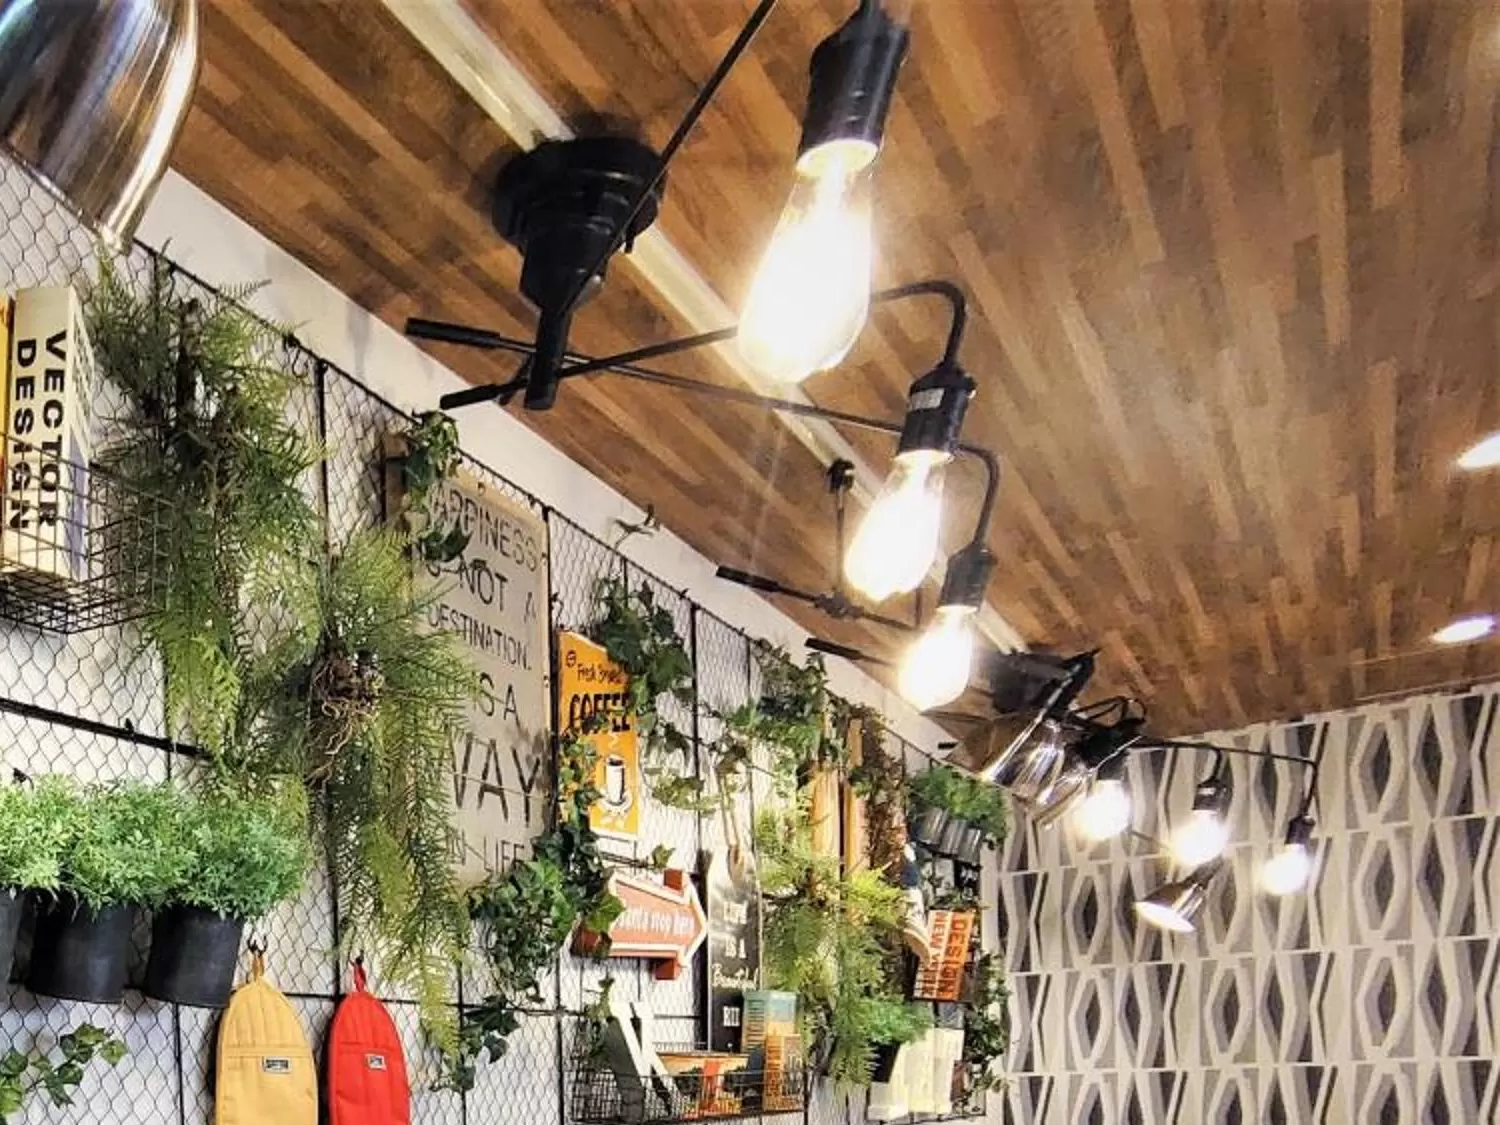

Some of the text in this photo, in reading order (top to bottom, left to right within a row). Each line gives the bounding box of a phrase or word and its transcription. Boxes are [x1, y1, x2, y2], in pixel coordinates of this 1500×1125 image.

[9, 339, 38, 529] DESIGN
[39, 330, 67, 527] VECTOR
[459, 554, 508, 613] NOT
